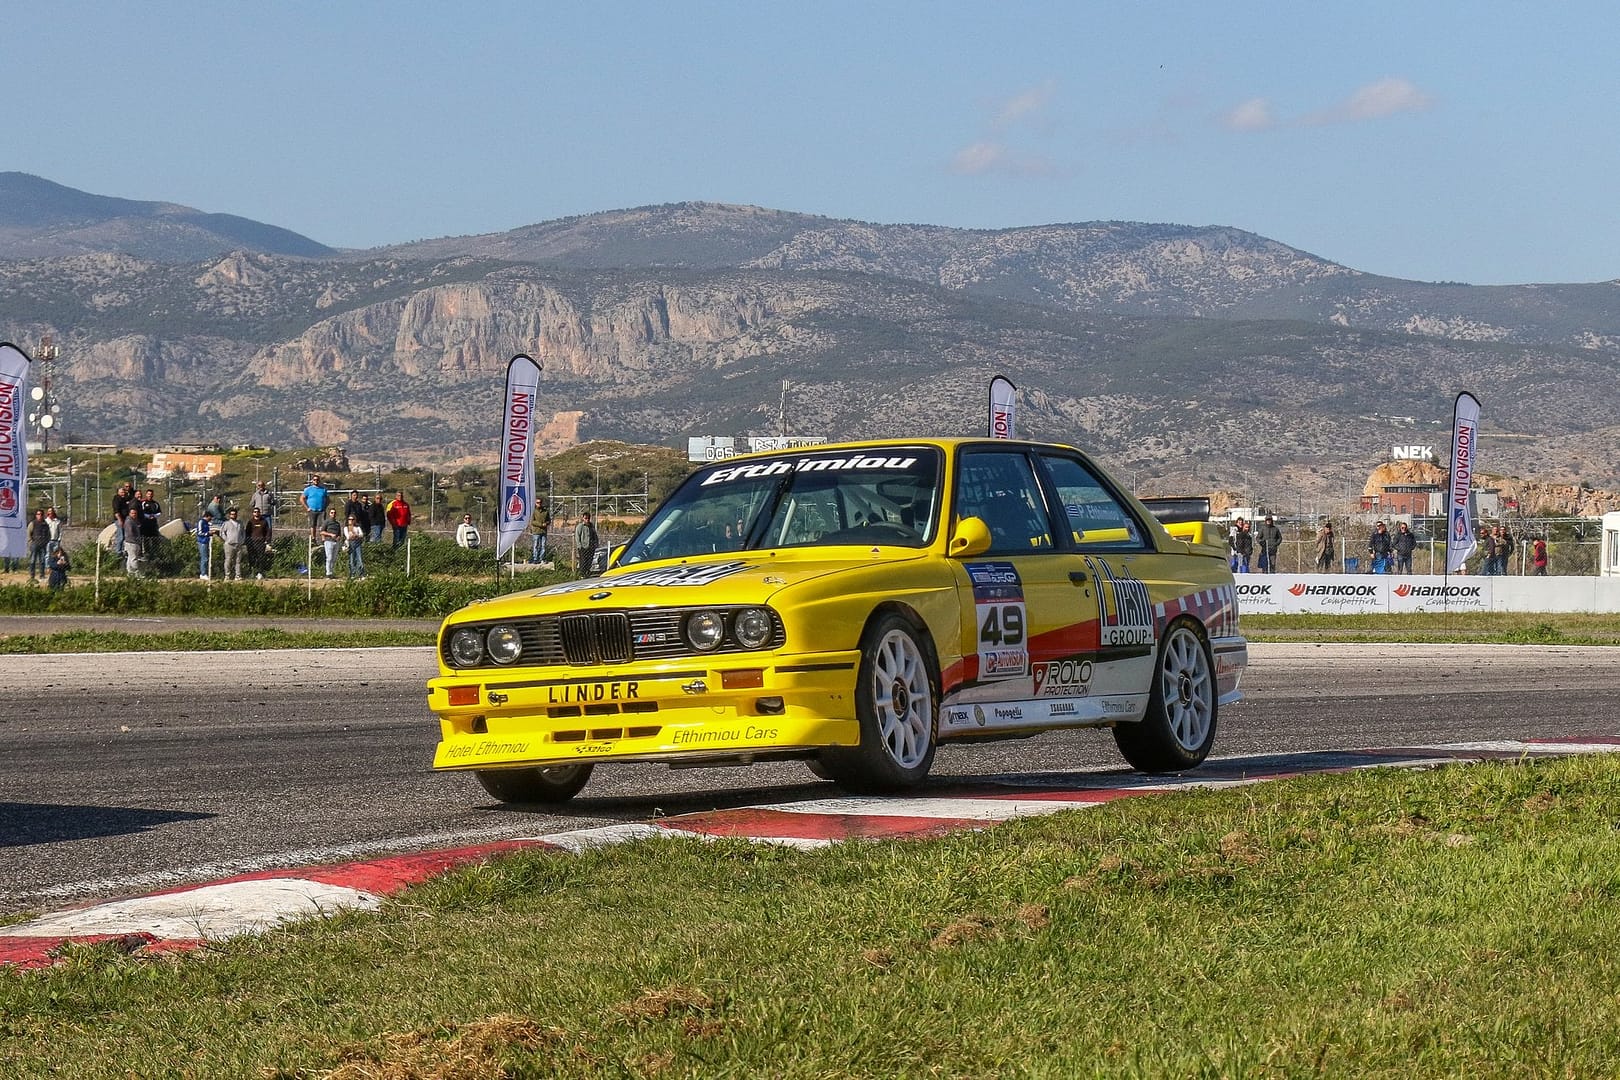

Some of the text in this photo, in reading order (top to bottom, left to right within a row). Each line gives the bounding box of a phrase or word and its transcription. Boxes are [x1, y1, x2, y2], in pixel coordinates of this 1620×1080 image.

[0, 383, 14, 475] AUTOVISION
[995, 411, 1007, 440] ION
[507, 393, 528, 483] AUTOVISION
[1393, 445, 1433, 459] NEK
[700, 455, 919, 486] Efthimiou
[1455, 426, 1471, 506] AUTOVISION
[1321, 596, 1384, 609] Competition
[980, 605, 1024, 646] 49
[1110, 629, 1148, 645] GROUP
[1047, 662, 1092, 684] ROLO
[548, 681, 639, 703] LINDER
[1044, 685, 1089, 696] PROTECTION
[672, 726, 779, 744] Efthimiou Cars
[445, 741, 530, 759] Hotel Efthimiou
